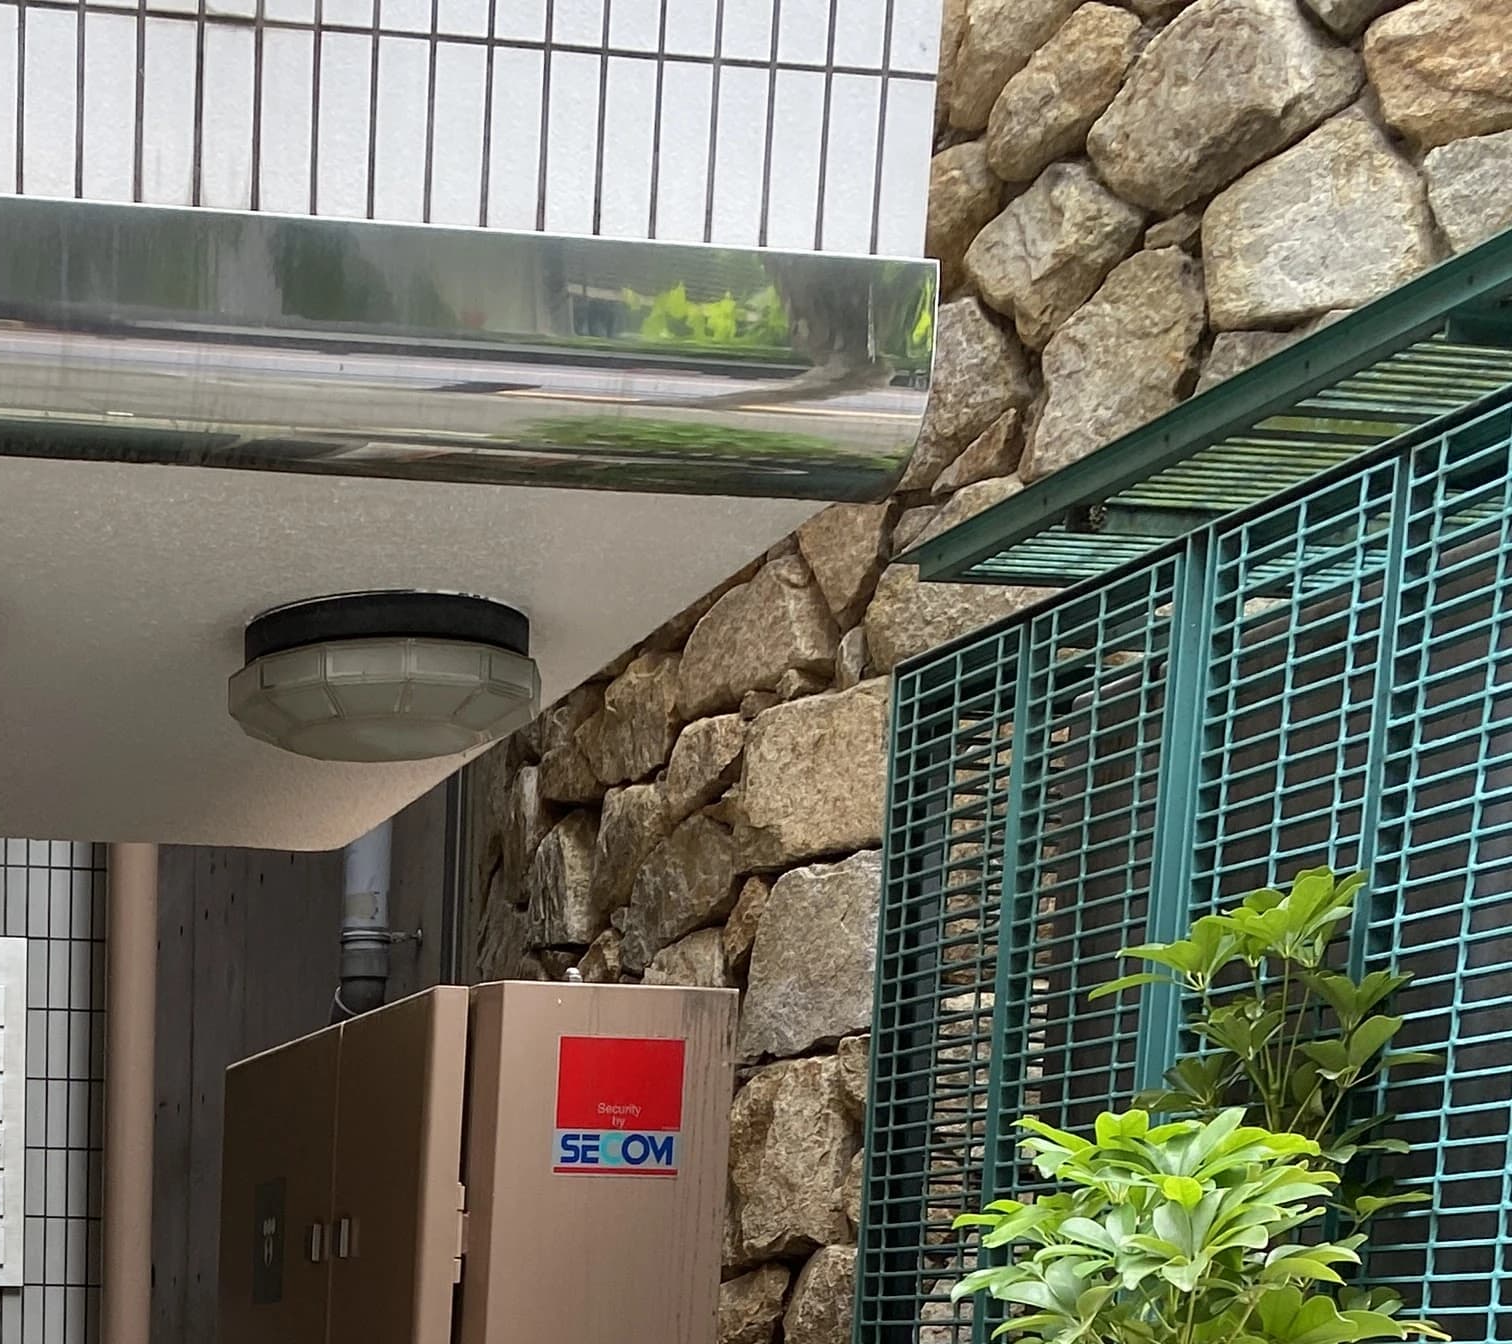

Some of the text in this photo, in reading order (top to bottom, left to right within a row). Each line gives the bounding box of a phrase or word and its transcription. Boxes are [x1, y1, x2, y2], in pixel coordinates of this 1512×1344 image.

[597, 1102, 642, 1118] Security
[612, 1115, 626, 1128] by
[560, 1133, 674, 1166] SECOM
